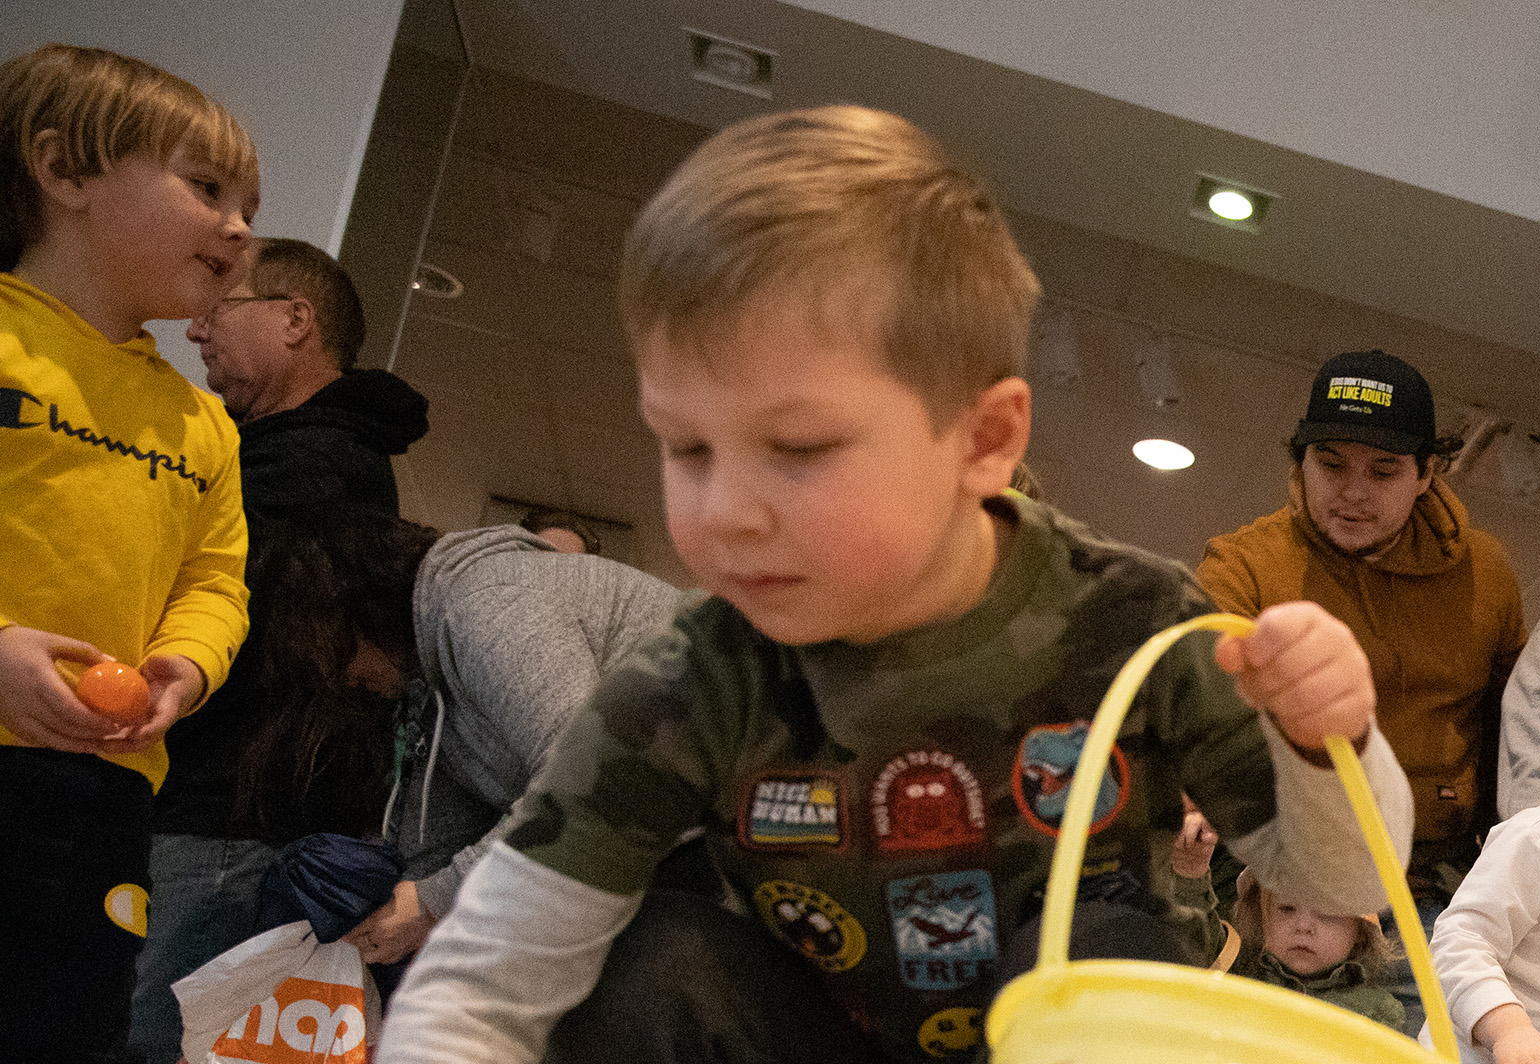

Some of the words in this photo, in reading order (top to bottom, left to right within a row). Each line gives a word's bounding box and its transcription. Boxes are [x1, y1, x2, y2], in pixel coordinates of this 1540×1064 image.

[1327, 385, 1343, 399] ACT
[1342, 385, 1360, 400] LIKE
[1360, 387, 1392, 407] ADULTS
[0, 386, 207, 493] Champi
[756, 781, 810, 803] NICE
[752, 799, 838, 824] HUMAN
[903, 957, 998, 983] FRE
